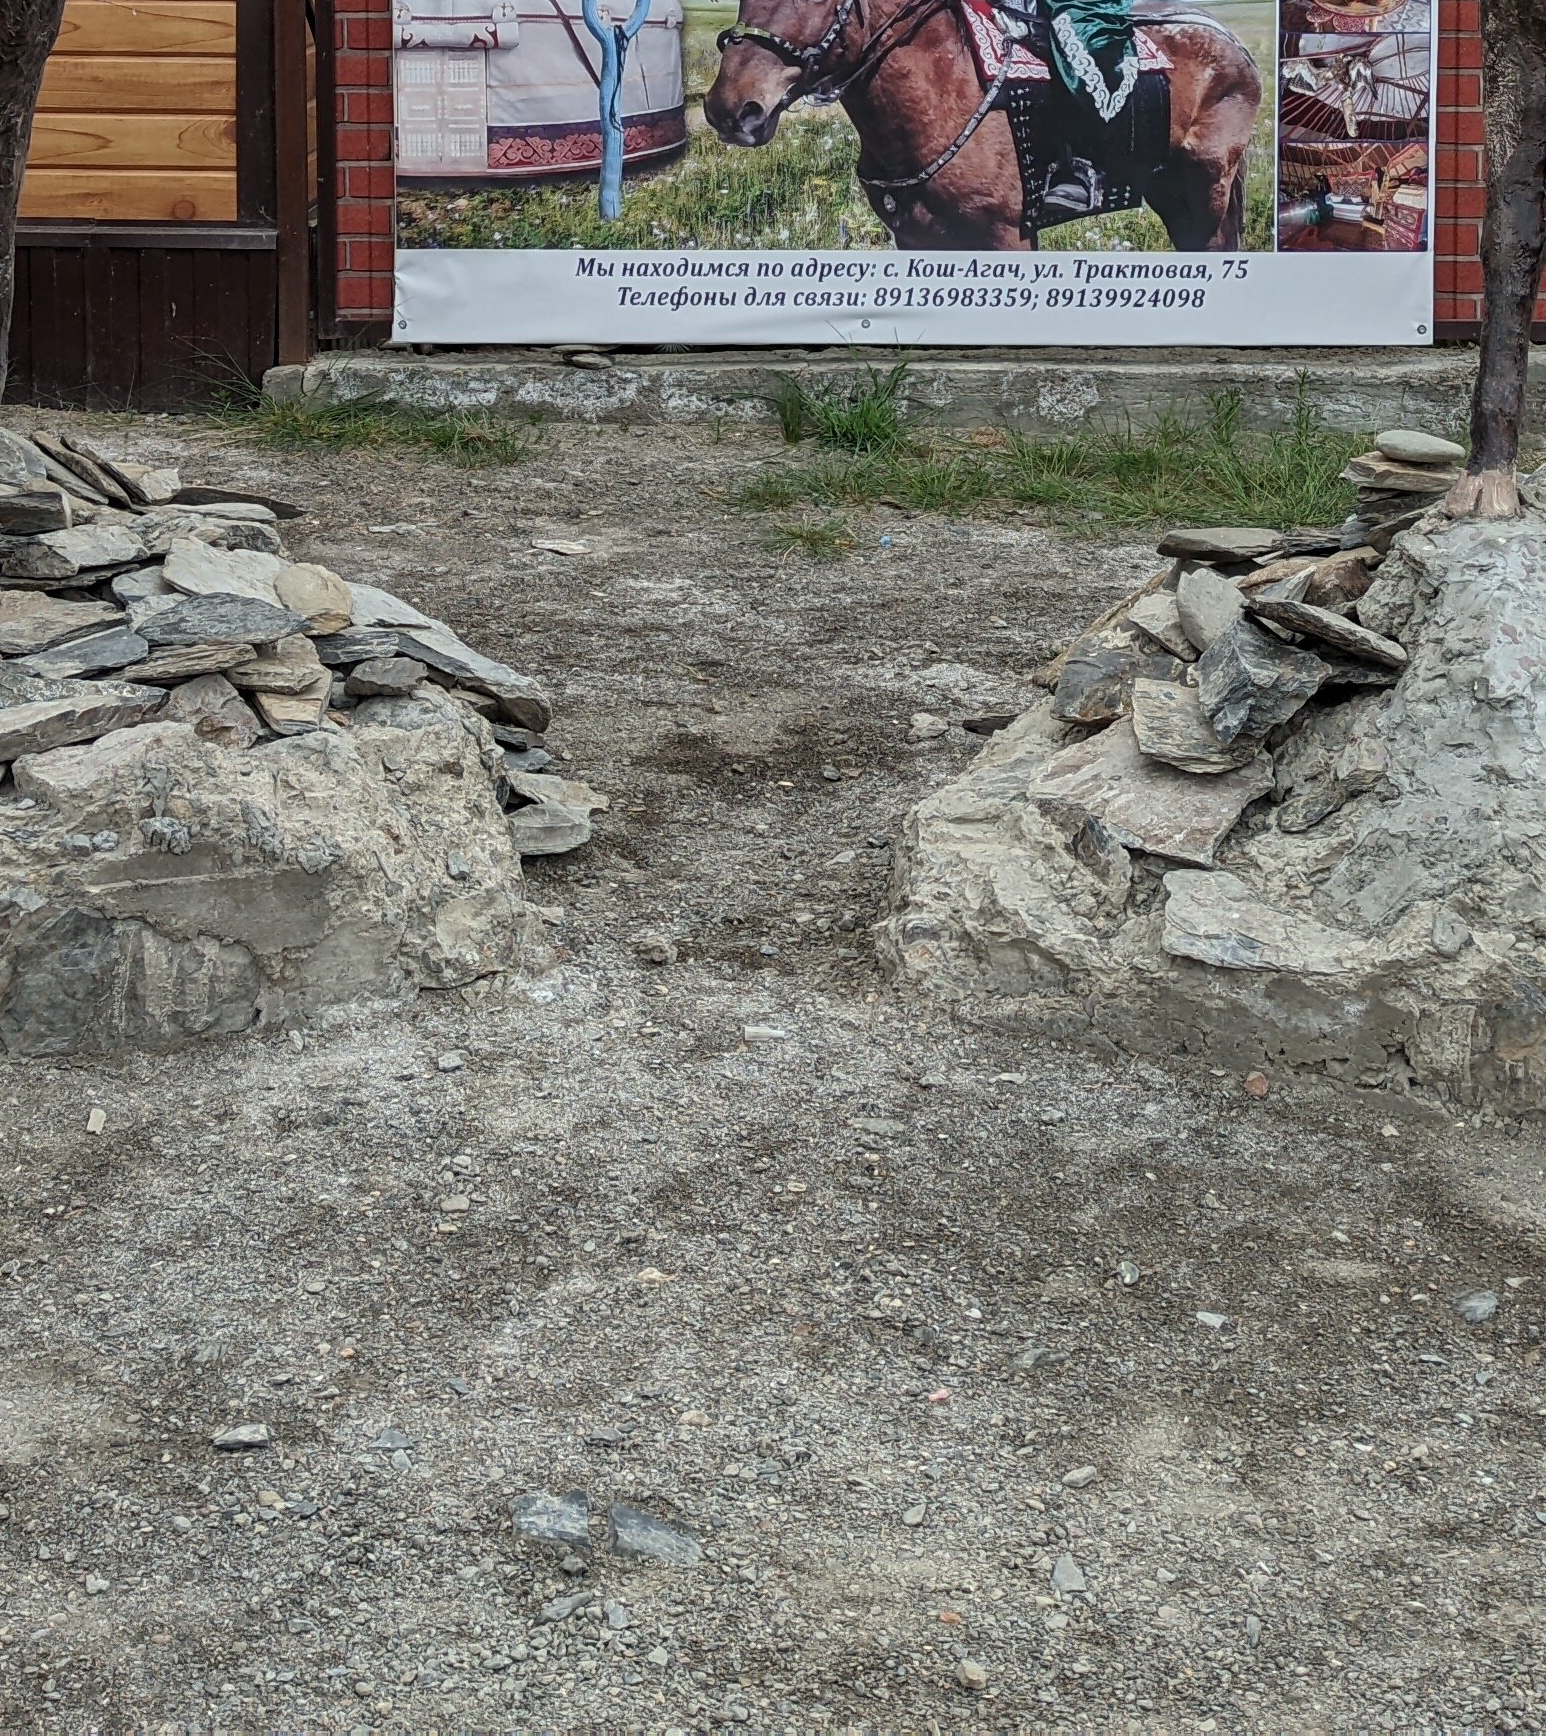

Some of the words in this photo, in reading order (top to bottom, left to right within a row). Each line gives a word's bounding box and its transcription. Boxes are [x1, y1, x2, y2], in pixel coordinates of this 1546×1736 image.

[575, 257, 615, 277] Мы
[621, 258, 750, 278] находимся
[756, 262, 784, 278] по
[790, 257, 877, 283] адресу:
[883, 263, 899, 278] с.
[906, 258, 1026, 282] Кош-Агач,
[1030, 263, 1064, 284] ул.
[1072, 259, 1213, 284] Трактовая,
[1221, 259, 1249, 279] 75
[617, 285, 737, 312] Телефоны
[743, 286, 786, 307] для
[793, 291, 867, 307] связи:
[873, 286, 1039, 311] 89136983359;
[1045, 287, 1206, 308] 89139924098
